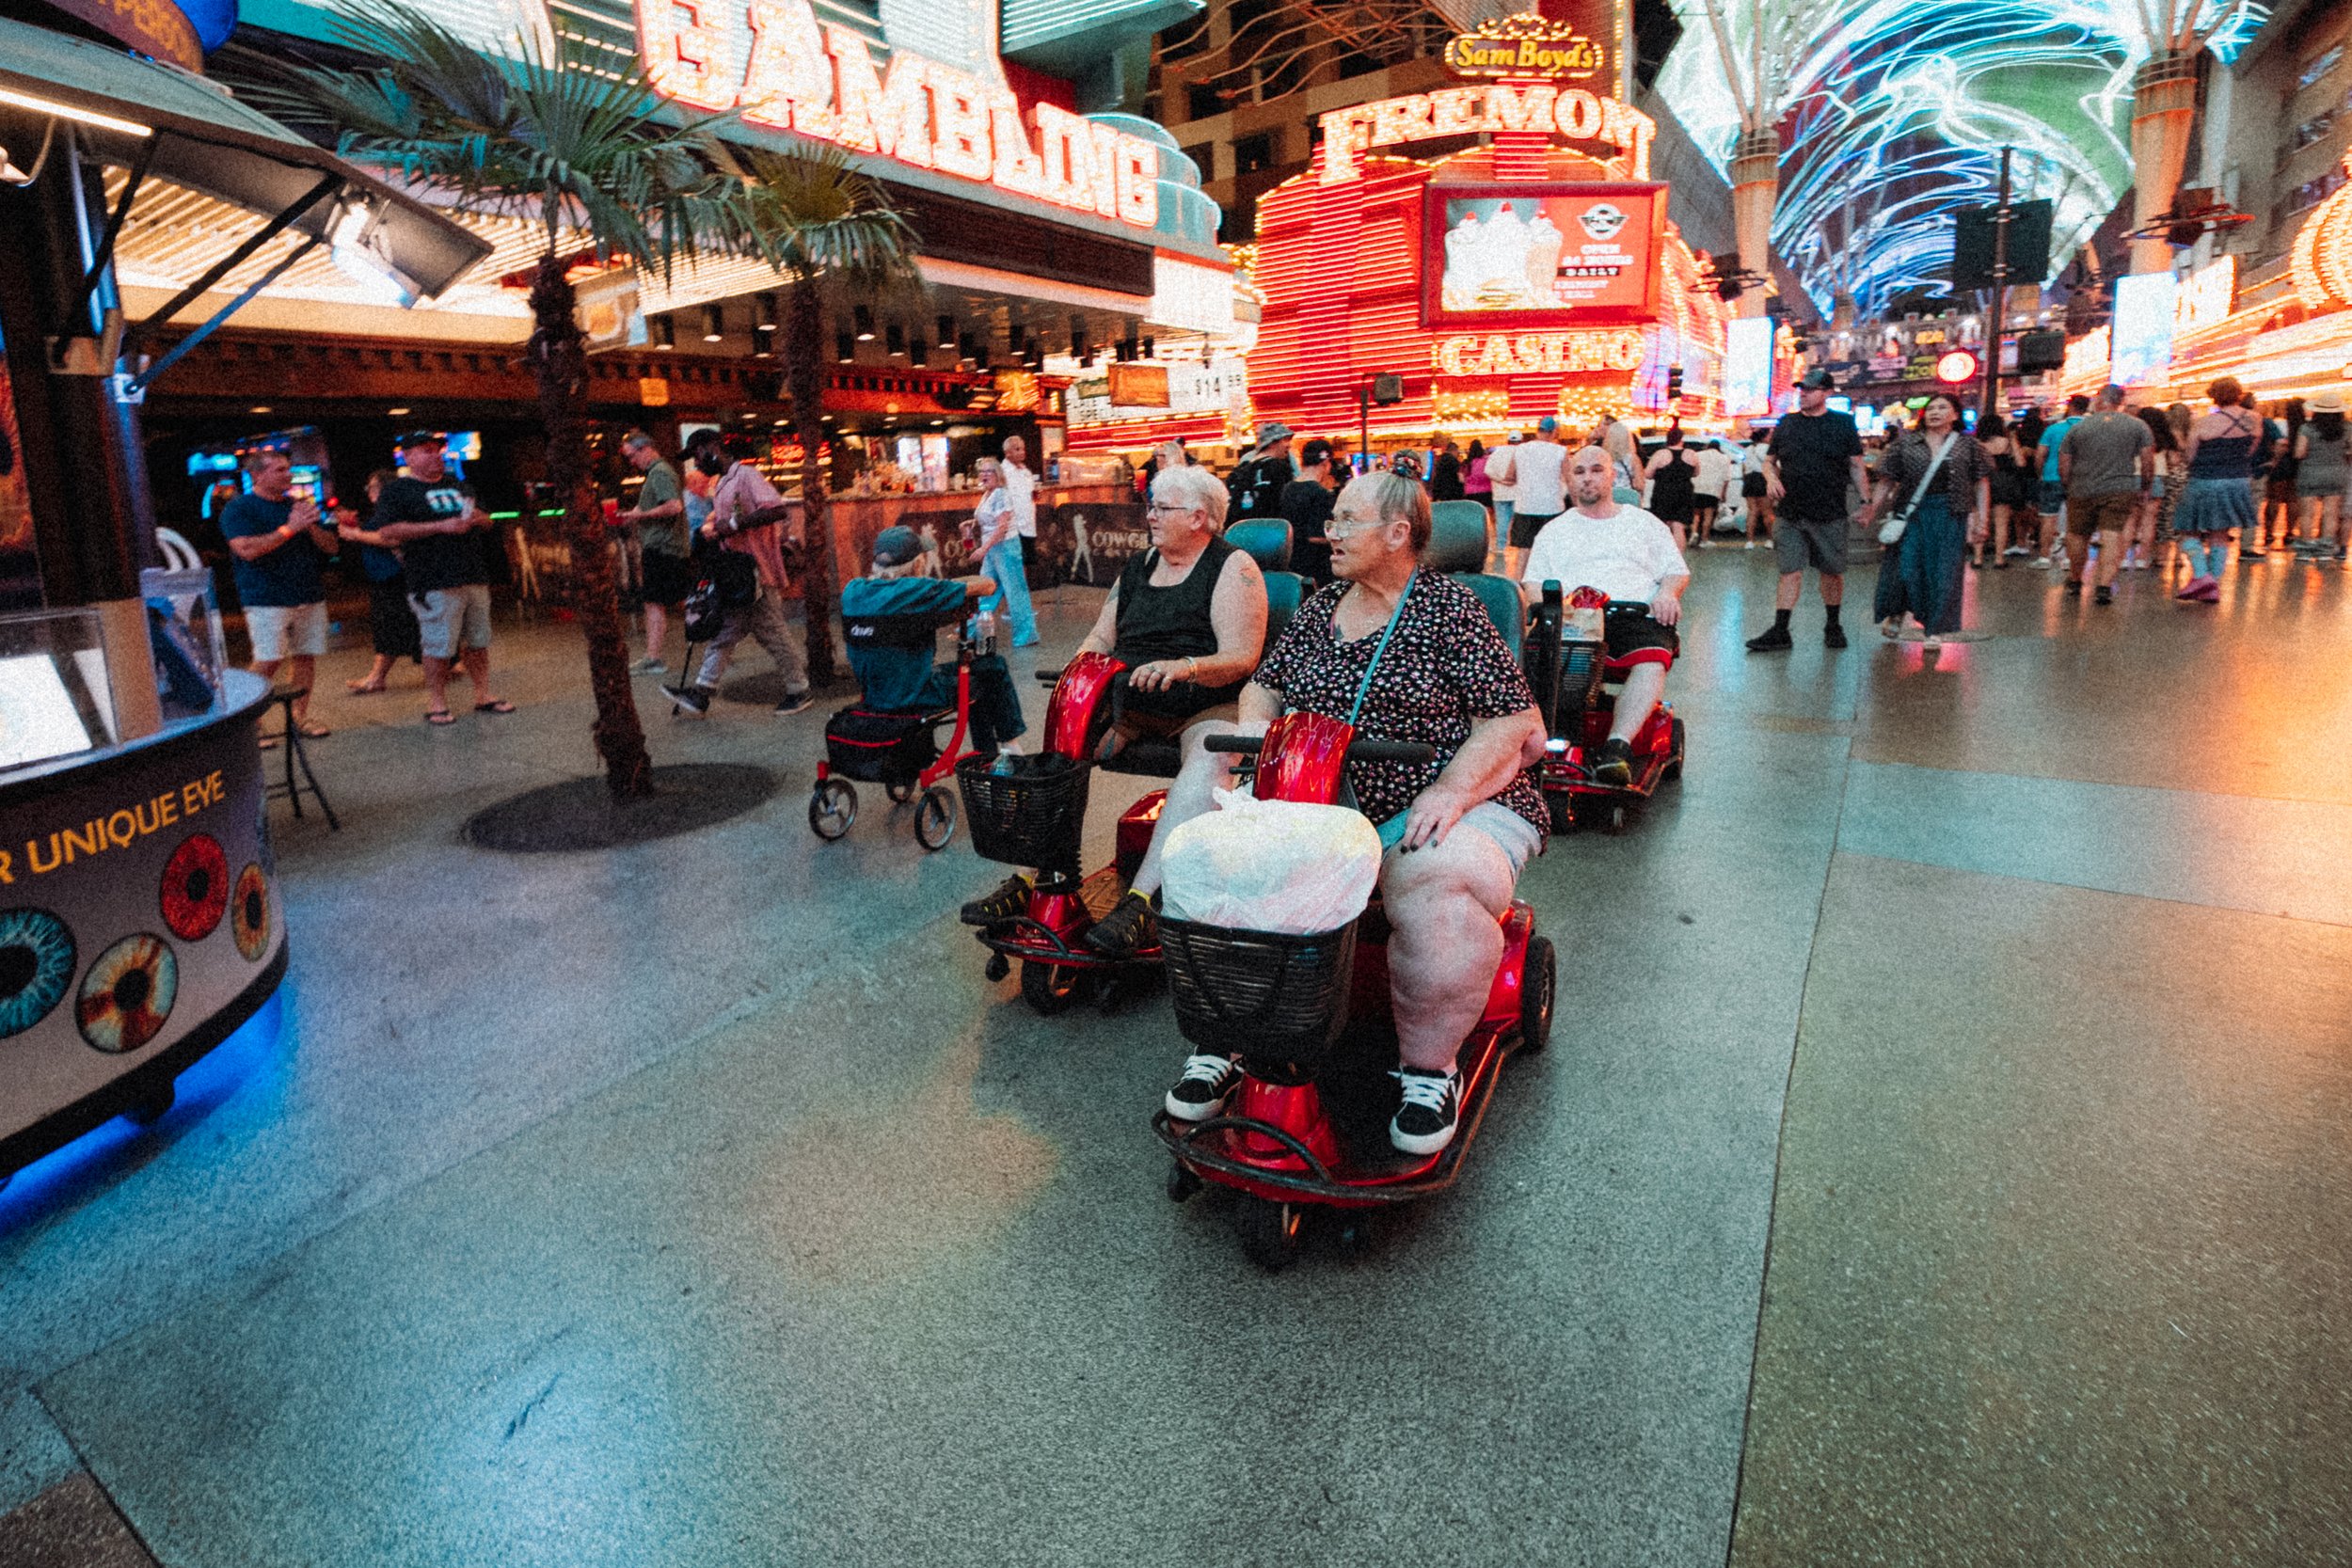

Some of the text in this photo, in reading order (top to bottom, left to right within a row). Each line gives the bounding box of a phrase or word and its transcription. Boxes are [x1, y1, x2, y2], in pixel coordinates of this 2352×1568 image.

[1457, 40, 1594, 71] Sam Boyd's
[636, 0, 1158, 228] GAMBLING
[1318, 85, 1657, 186] FREMONT
[1565, 267, 1618, 277] DAILY
[1439, 331, 1646, 376] CASINO
[26, 791, 179, 874] UNIQUE
[182, 769, 226, 816] EYE
